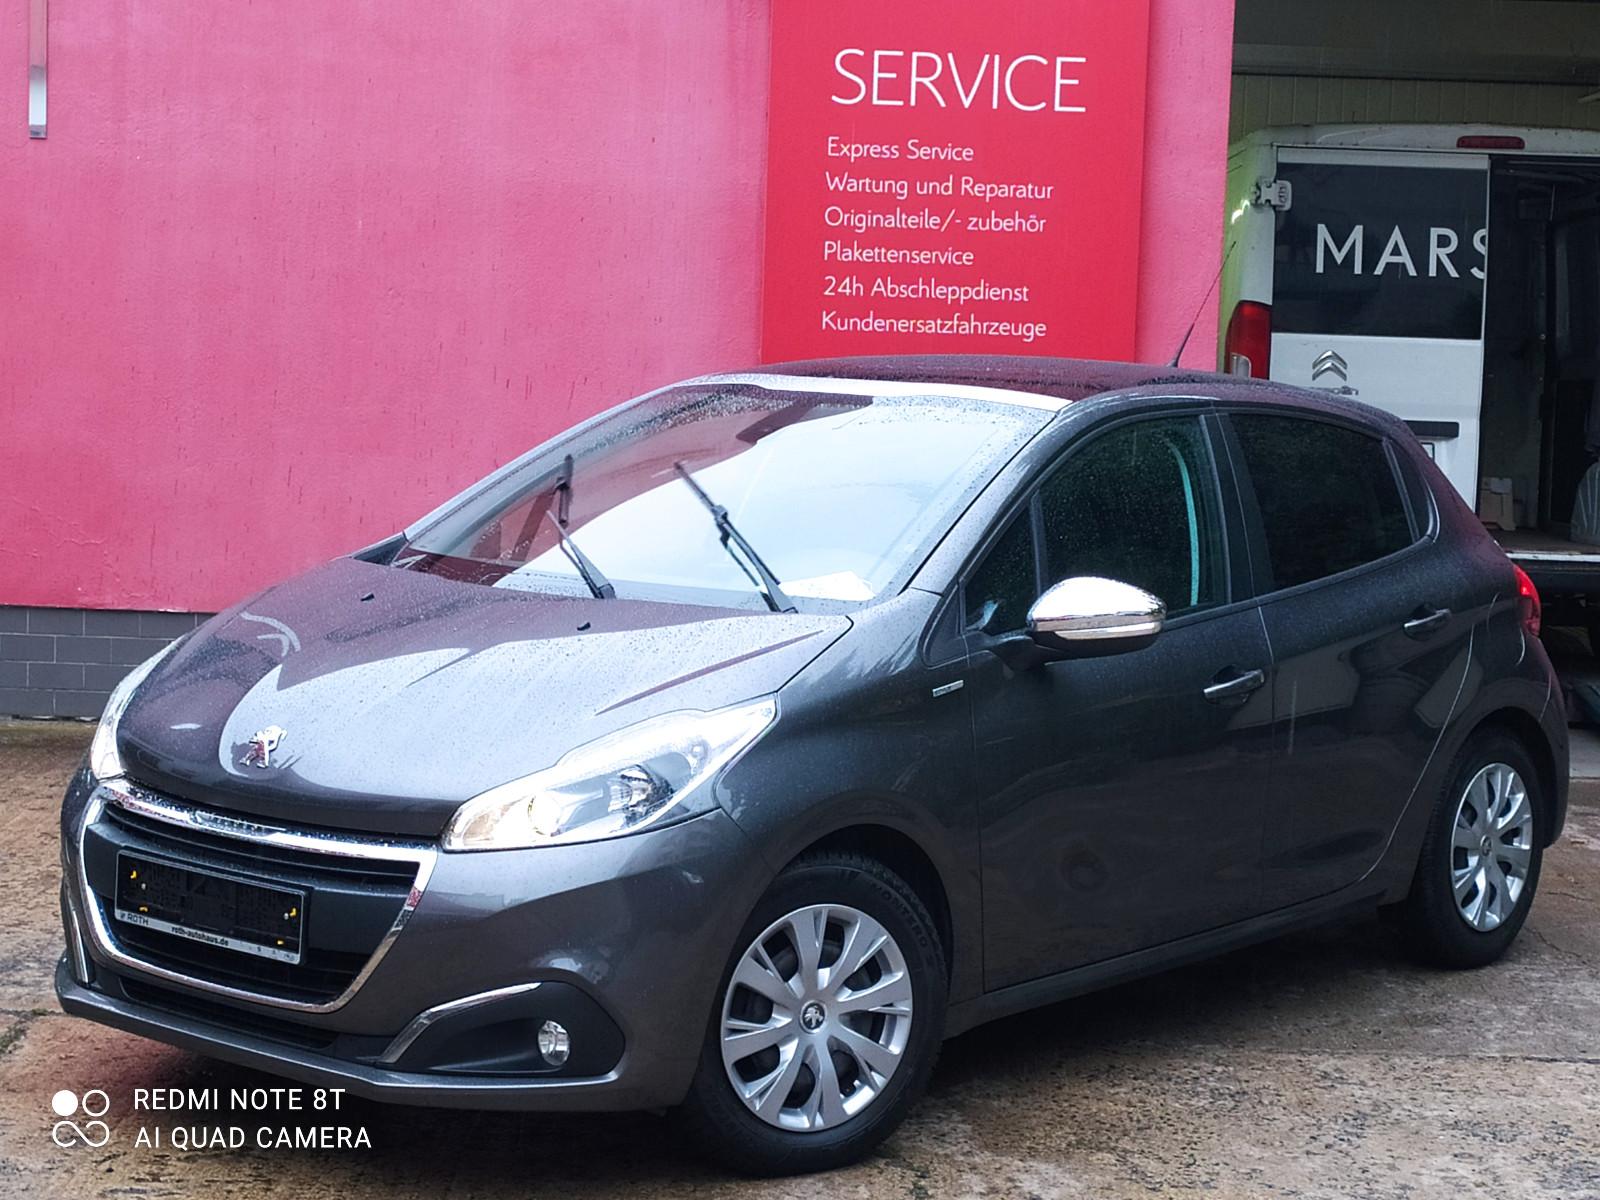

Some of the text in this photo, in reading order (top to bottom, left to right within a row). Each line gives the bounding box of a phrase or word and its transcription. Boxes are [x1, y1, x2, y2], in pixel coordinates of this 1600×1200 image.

[832, 49, 1086, 112] SERVICE
[828, 137, 973, 162] Express Service
[826, 172, 1053, 202] Wartung und Reparatur
[968, 210, 1046, 232] zubehör
[825, 240, 974, 265] Plakettenservice
[824, 276, 1028, 304] 24h Abschleppdienst
[823, 311, 1046, 342] Kundenersatzfahrzeuge
